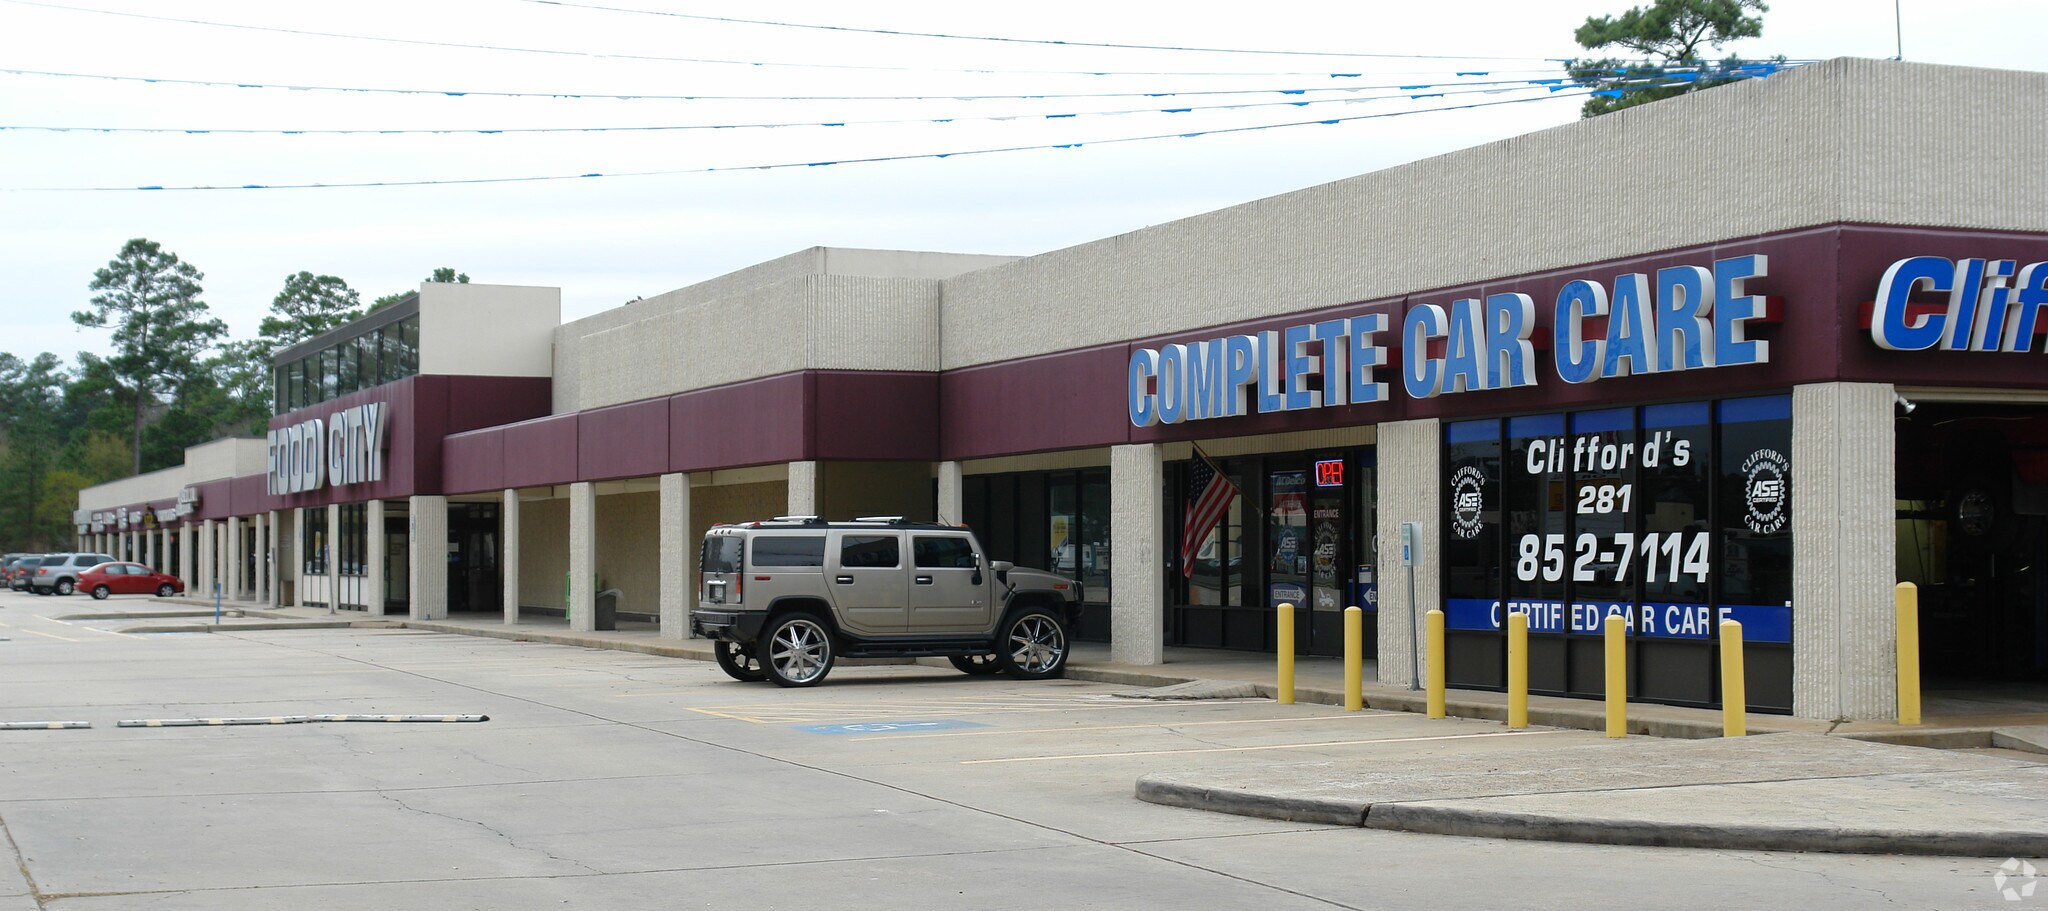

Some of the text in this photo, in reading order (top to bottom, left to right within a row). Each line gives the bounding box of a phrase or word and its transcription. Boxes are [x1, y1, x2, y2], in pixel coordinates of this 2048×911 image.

[1129, 254, 1769, 427] COMPLETE CAR CARE
[267, 401, 386, 496] FOOD CITY
[1526, 430, 1690, 474] Clifford's
[1741, 448, 1790, 473] CLIFFORD'S
[1450, 466, 1486, 487] CLIFFORD'S
[1577, 484, 1632, 514] 281
[1751, 480, 1779, 497] ASE
[1458, 492, 1478, 507] ASE
[1313, 508, 1339, 518] ENTRANCE
[1744, 512, 1787, 534] CAR CARE
[1452, 520, 1484, 539] CAR CARE
[1280, 536, 1296, 549] ASE
[1516, 532, 1710, 583] 852-7114
[1274, 590, 1300, 599] ENTRANCE
